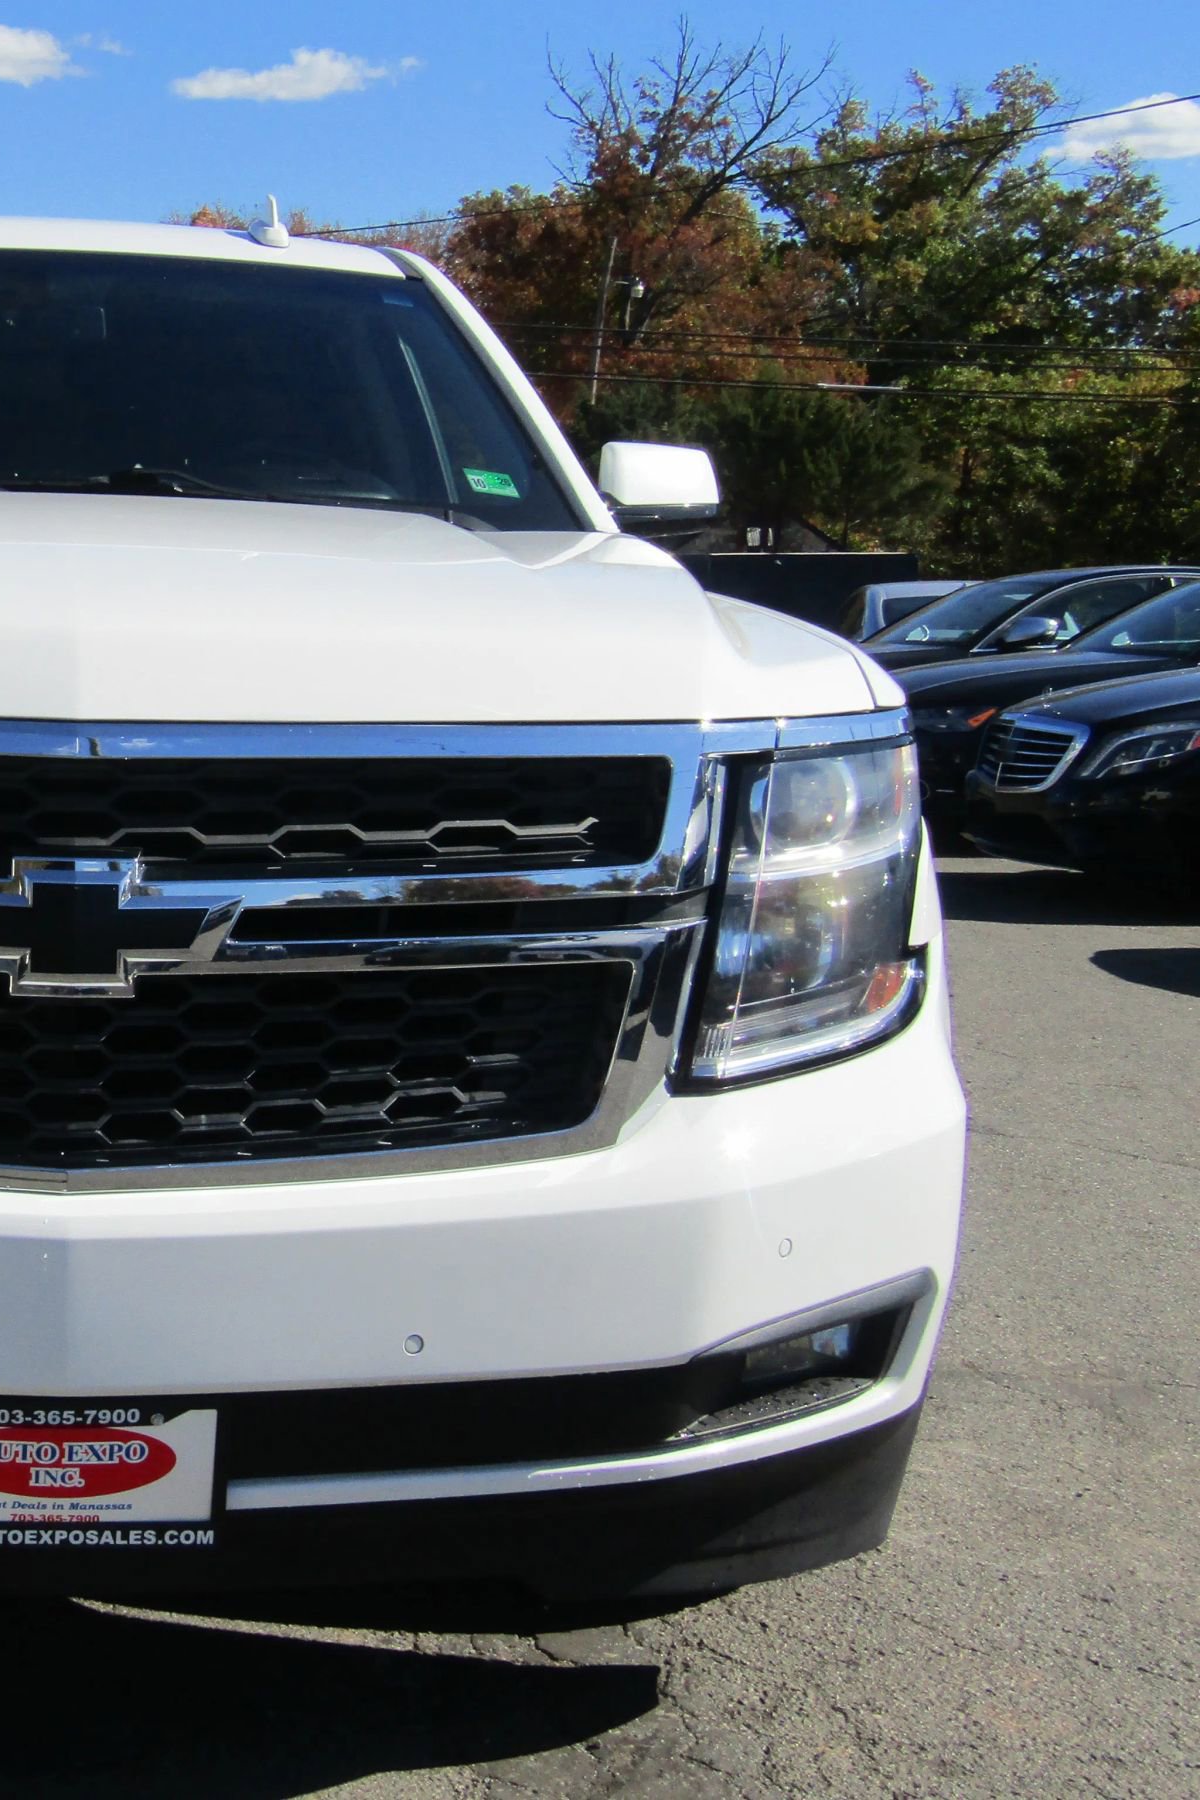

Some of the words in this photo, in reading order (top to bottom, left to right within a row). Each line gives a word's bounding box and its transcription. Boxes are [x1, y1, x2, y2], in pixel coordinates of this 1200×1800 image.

[471, 478, 487, 489] 10
[62, 1441, 148, 1464] EXPO
[29, 1467, 85, 1487] INC.
[11, 1501, 47, 1510] Deals
[52, 1502, 64, 1510] in
[69, 1502, 133, 1511] Manassas
[10, 1513, 100, 1522] 703-365-7900
